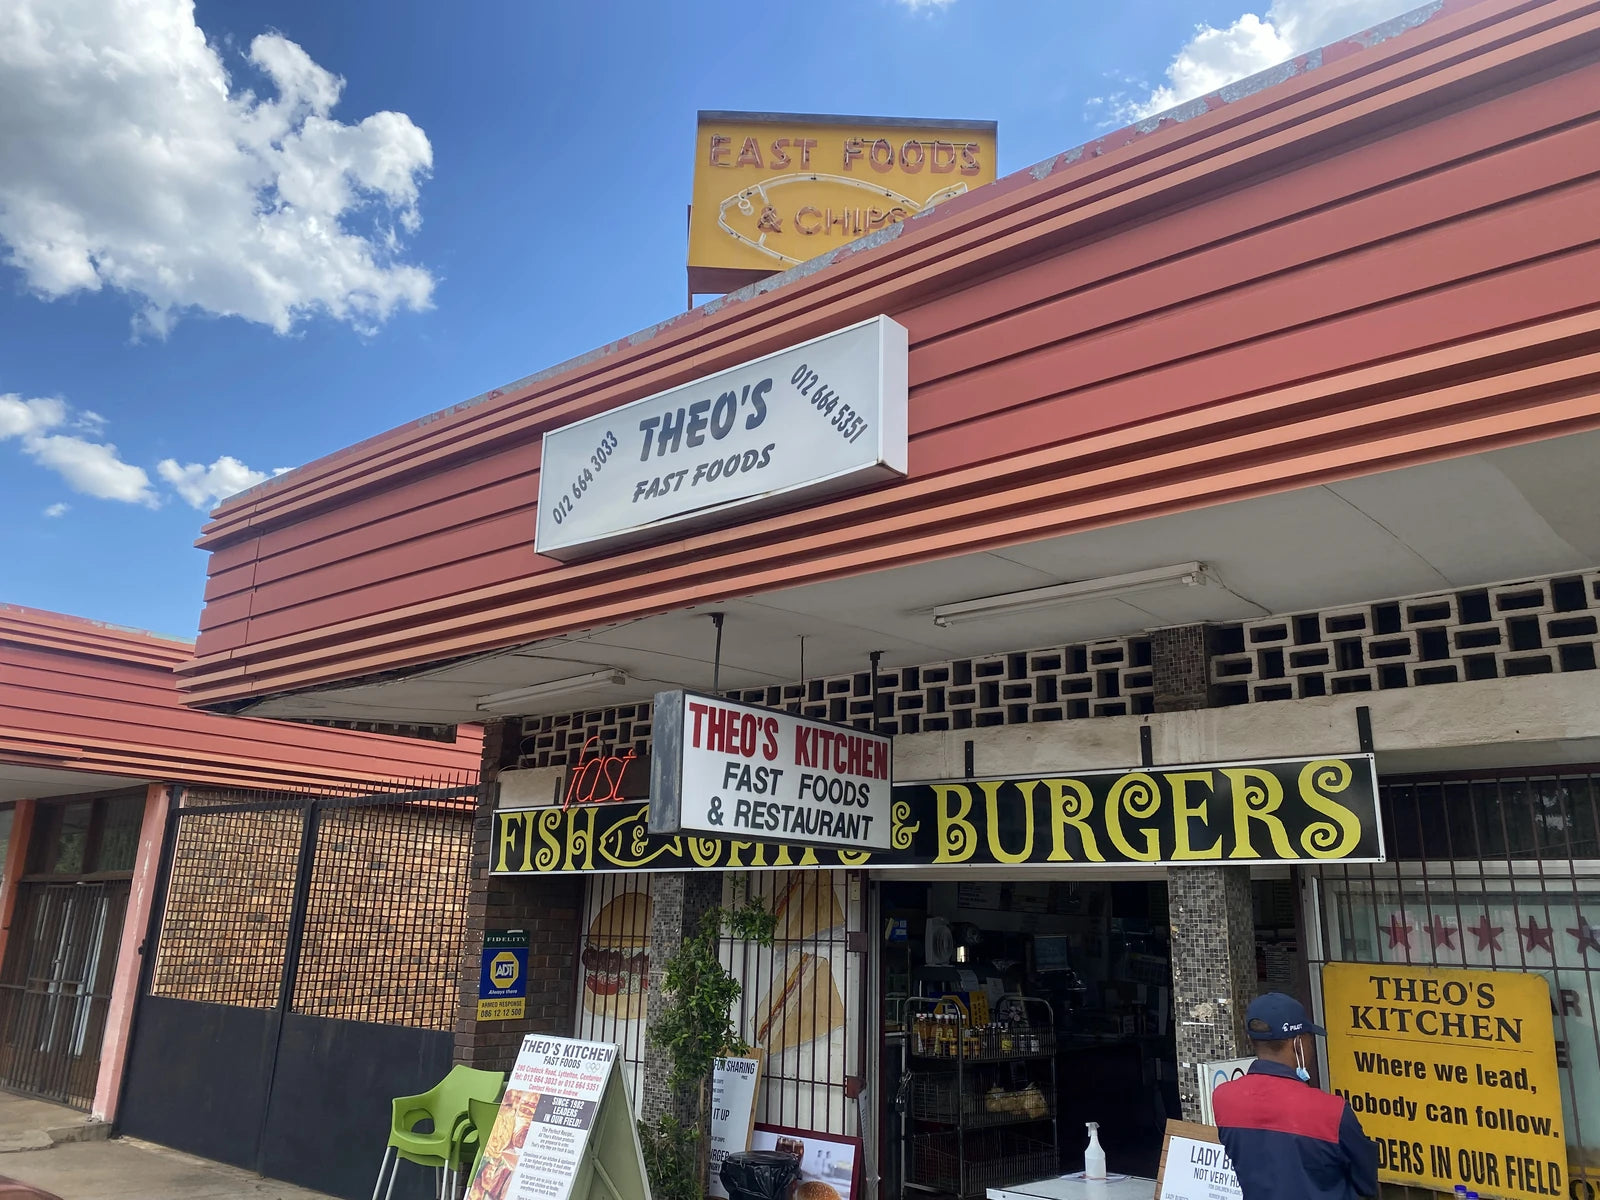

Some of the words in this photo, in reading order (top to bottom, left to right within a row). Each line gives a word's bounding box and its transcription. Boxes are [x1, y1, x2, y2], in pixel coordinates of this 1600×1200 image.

[709, 134, 818, 170] EAST
[844, 137, 981, 176] FOODS
[757, 205, 783, 233] &
[639, 378, 773, 462] THEO'S
[791, 363, 819, 396] 012
[811, 384, 839, 417] 664
[831, 403, 868, 444] 5351
[553, 495, 573, 524] 012
[572, 468, 593, 499] 664
[591, 431, 617, 472] 3033
[632, 469, 689, 503] FAST
[691, 443, 776, 487] FOODS
[689, 702, 779, 761] THEO'S
[795, 725, 889, 780] KITCHEN
[562, 736, 637, 812] fast
[723, 761, 784, 796] FAST
[798, 773, 870, 808] FOODS
[495, 808, 600, 871] FISH
[631, 825, 649, 856] &
[931, 759, 1362, 864] BURGERS
[707, 796, 724, 826] &
[734, 799, 873, 841] RESTAURANT
[495, 963, 514, 977] ADT
[1369, 975, 1495, 1009] THEO'S
[503, 1009, 510, 1017] 12
[1350, 1005, 1523, 1043] KITCHEN
[522, 1040, 562, 1056] THEO'S
[563, 1044, 614, 1062] KITCHEN
[543, 1056, 560, 1066] FAST
[560, 1058, 582, 1069] FOODS
[726, 1060, 755, 1074] SHARING
[524, 1074, 533, 1082] 012
[564, 1079, 574, 1088] 012
[1354, 1051, 1427, 1080] Where
[1433, 1064, 1468, 1084] we
[1477, 1064, 1537, 1095] lead,
[721, 1110, 730, 1121] UP
[1426, 1102, 1468, 1125] can
[1476, 1106, 1560, 1138] follow.
[1190, 1145, 1221, 1167] LADY
[1375, 1137, 1424, 1176] DERS
[1430, 1144, 1453, 1180] IN
[1458, 1148, 1500, 1187] OUR
[1505, 1155, 1561, 1196] FIELD
[1193, 1167, 1209, 1181] NOT
[1210, 1170, 1229, 1185] VERY
